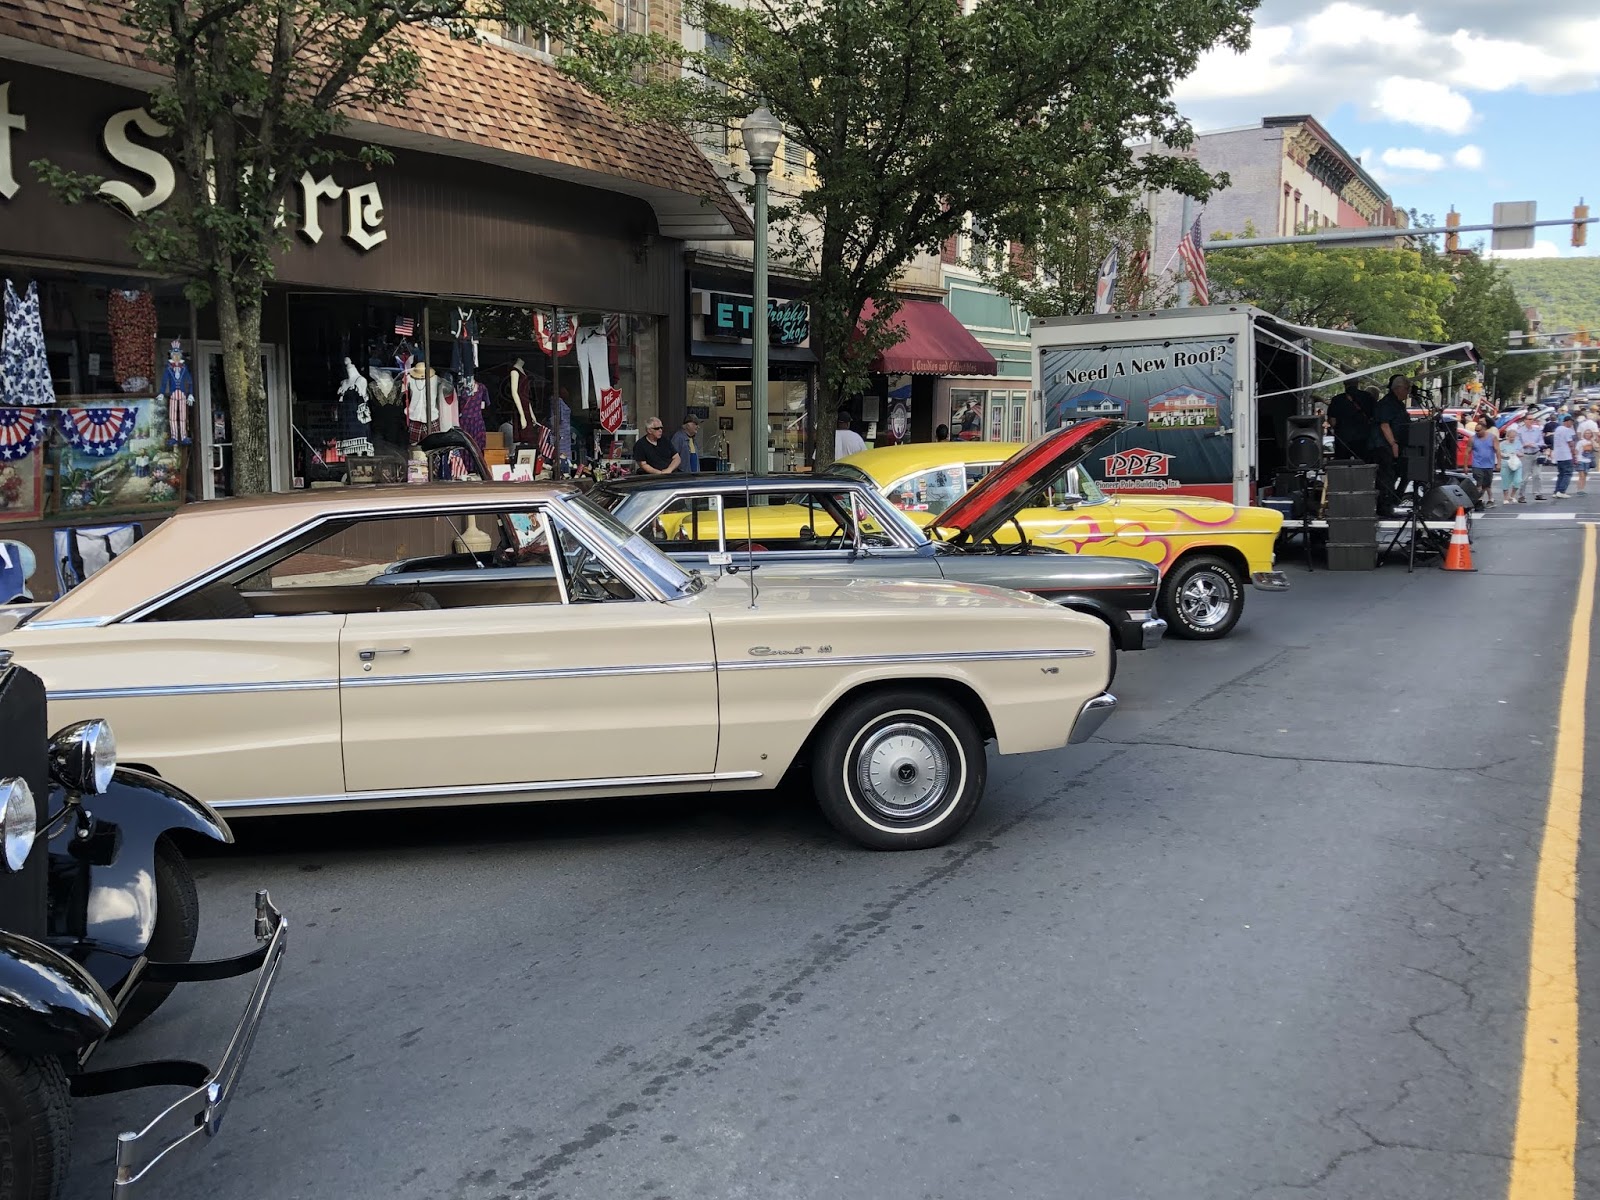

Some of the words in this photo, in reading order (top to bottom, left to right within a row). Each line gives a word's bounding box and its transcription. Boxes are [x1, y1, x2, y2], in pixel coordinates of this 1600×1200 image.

[97, 107, 388, 250] Sre
[781, 321, 807, 343] Shop
[1065, 364, 1108, 385] Need
[1113, 362, 1126, 378] A
[1131, 356, 1169, 375] New
[1174, 345, 1227, 368] Roof?
[604, 390, 614, 406] THE
[1161, 415, 1205, 427] AFTER
[1110, 454, 1164, 475] PPB
[1095, 480, 1120, 489] Pioneer
[1120, 480, 1134, 489] Pole
[1135, 479, 1168, 490] Buildings,
[1168, 479, 1181, 488] Inc.
[1210, 565, 1239, 600] UNIROYAL
[1176, 607, 1189, 624] PAW
[1188, 624, 1215, 632] TIGER
